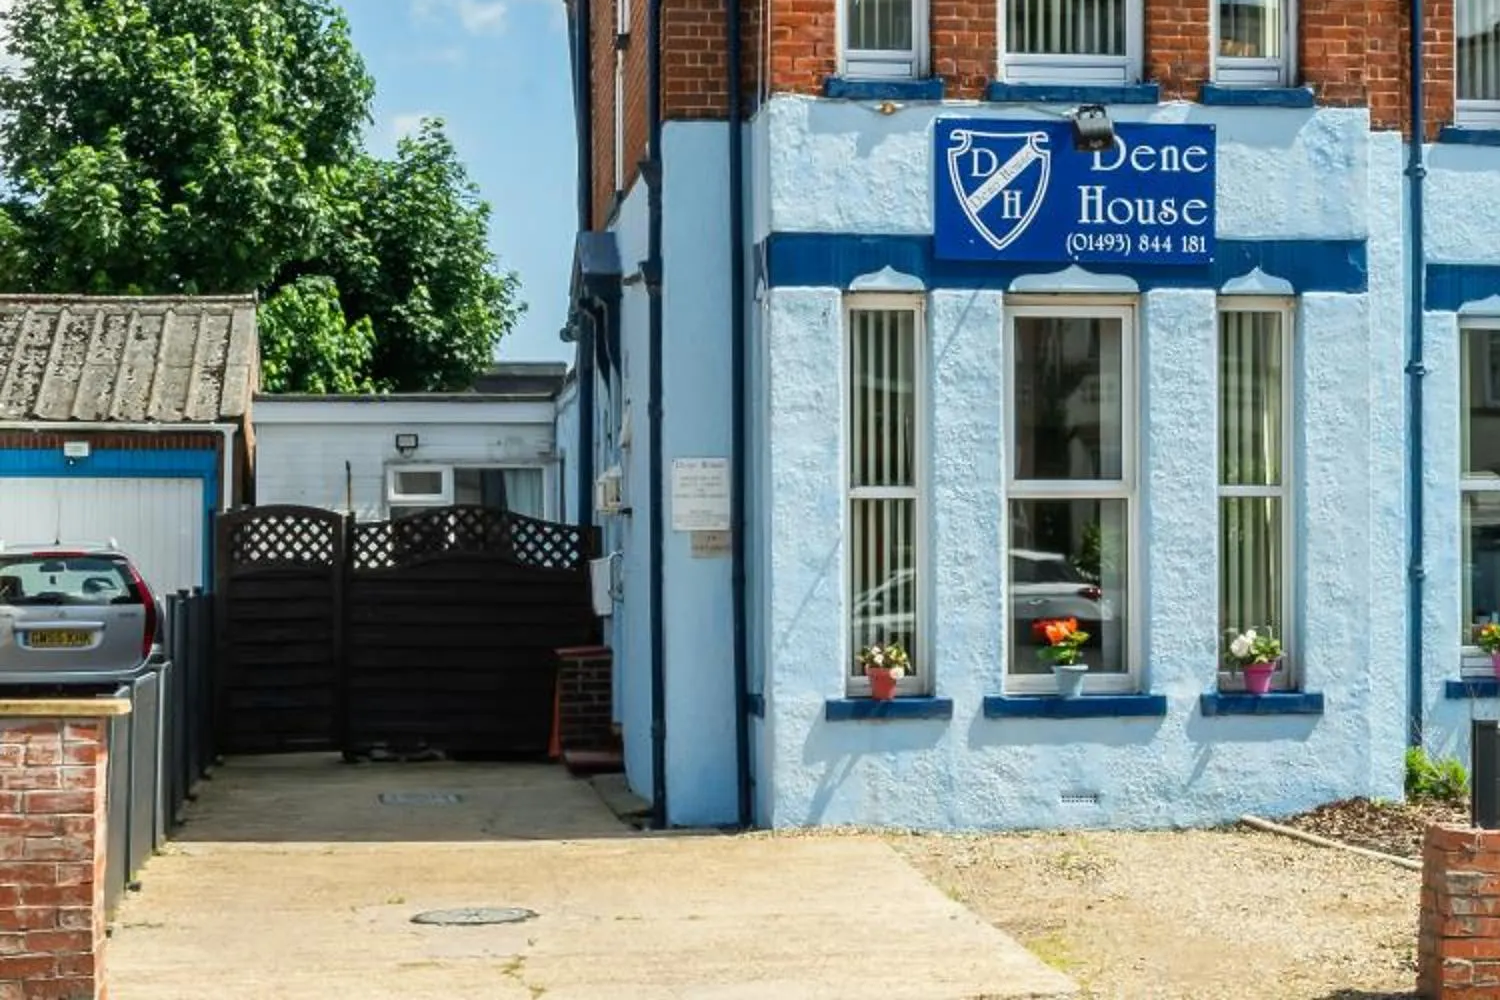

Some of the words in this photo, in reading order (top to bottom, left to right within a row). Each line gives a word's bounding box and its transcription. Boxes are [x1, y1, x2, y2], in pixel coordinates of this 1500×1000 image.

[970, 148, 998, 177] D
[1090, 135, 1208, 172] Dene
[1001, 189, 1023, 219] H
[1078, 185, 1208, 225] House
[1066, 232, 1131, 256] (01493)
[1138, 236, 1172, 253] 844
[1182, 235, 1207, 253] 181
